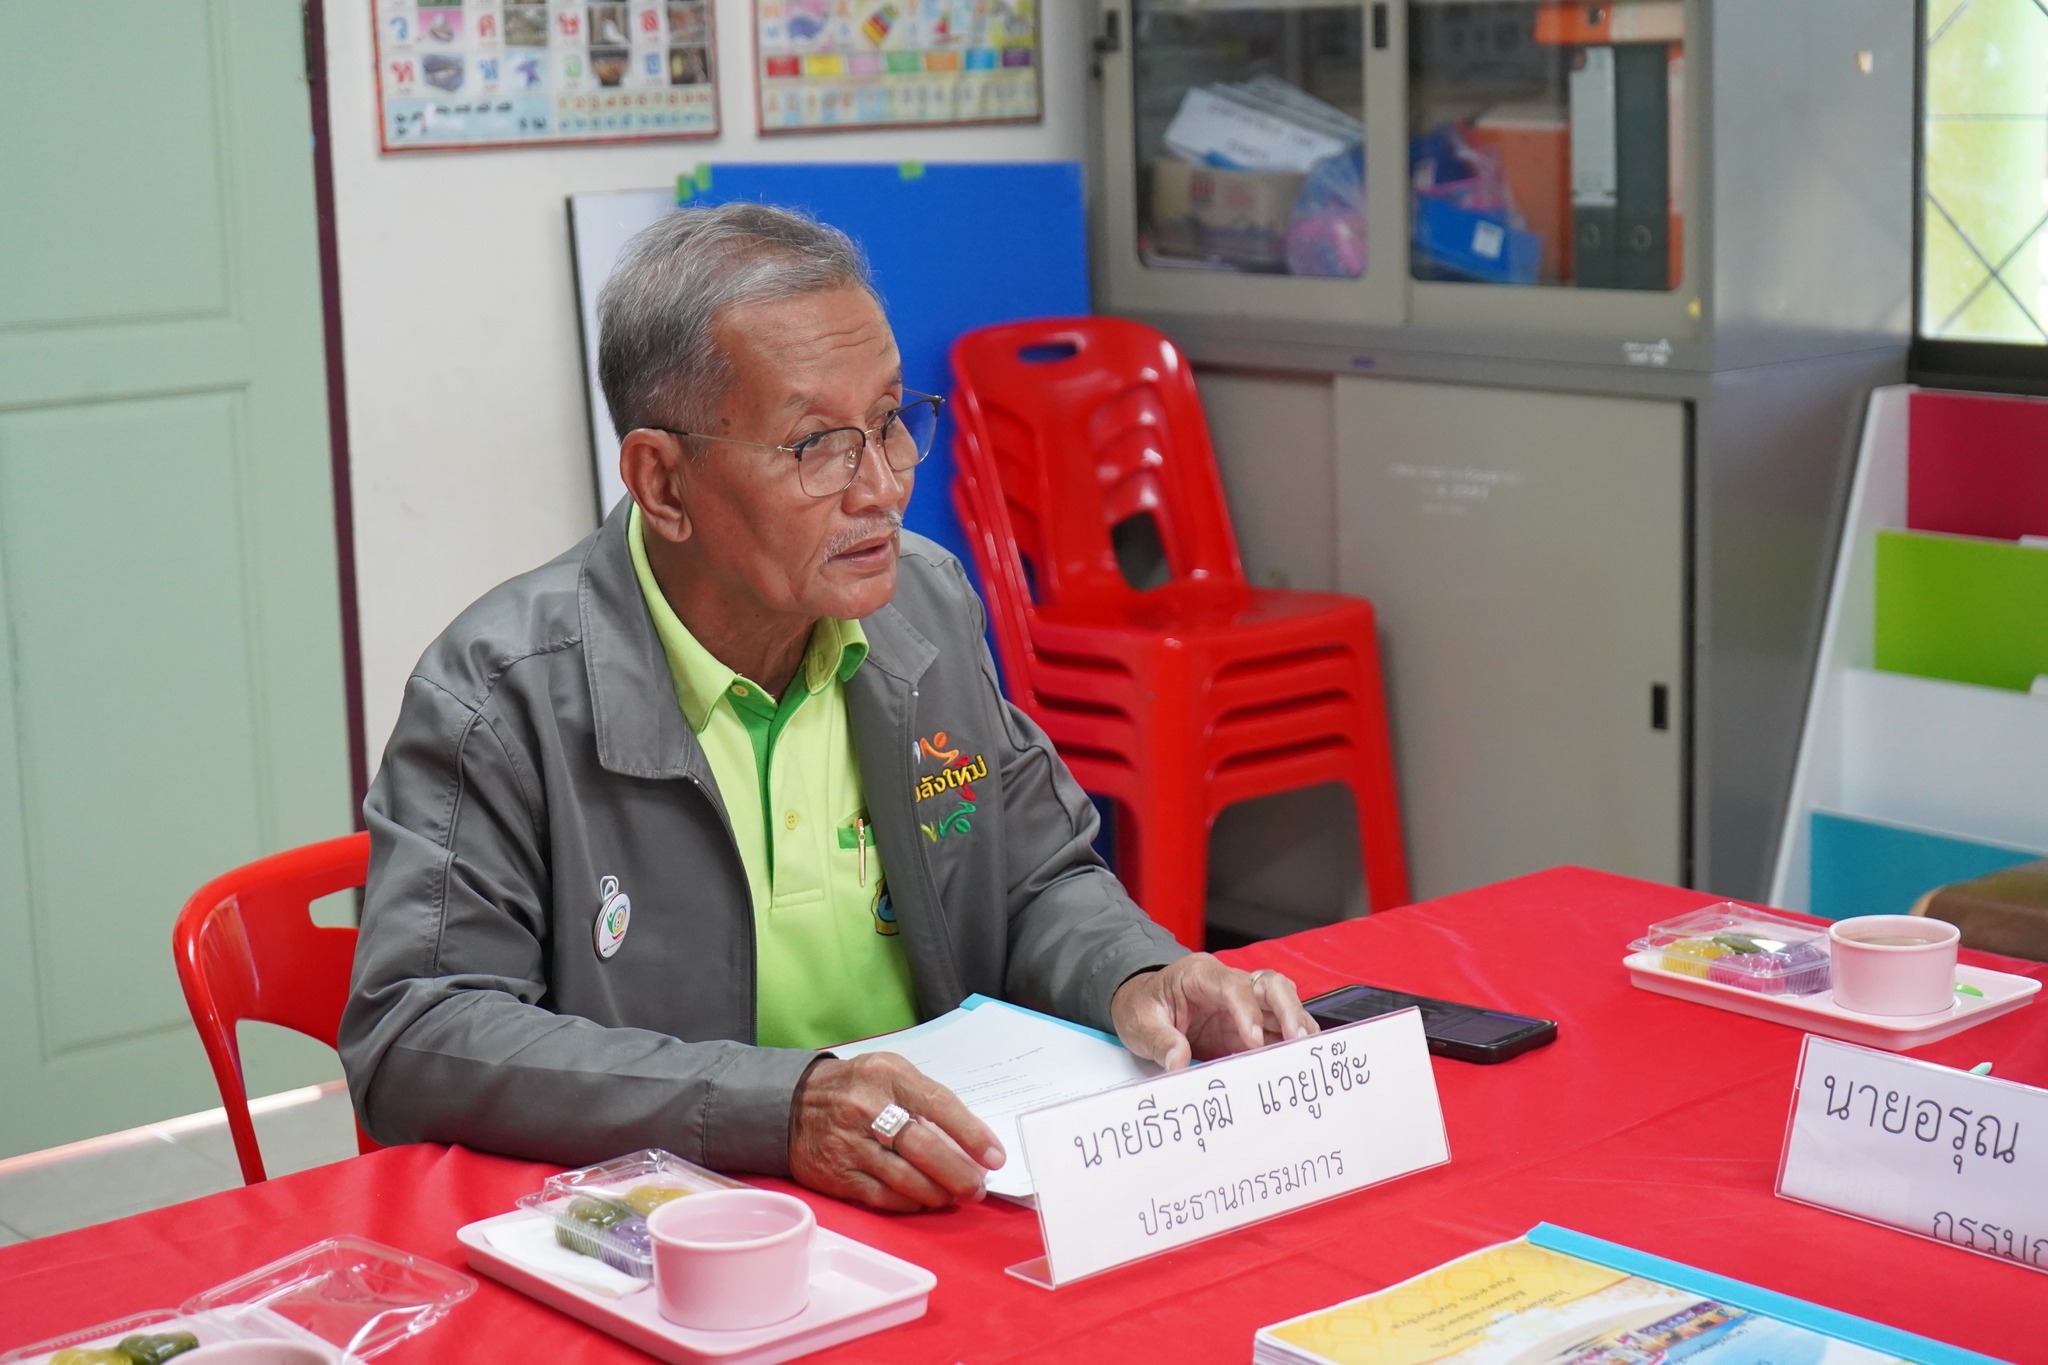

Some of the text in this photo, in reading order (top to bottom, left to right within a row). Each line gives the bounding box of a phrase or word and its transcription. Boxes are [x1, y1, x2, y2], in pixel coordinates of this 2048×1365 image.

[1073, 1039, 1371, 1168] นายธีรวุฒิ แวยูโซ๊ะ
[1824, 1074, 2020, 1175] นายอรุณ
[1138, 1149, 1345, 1237] ประธานกรรมการ
